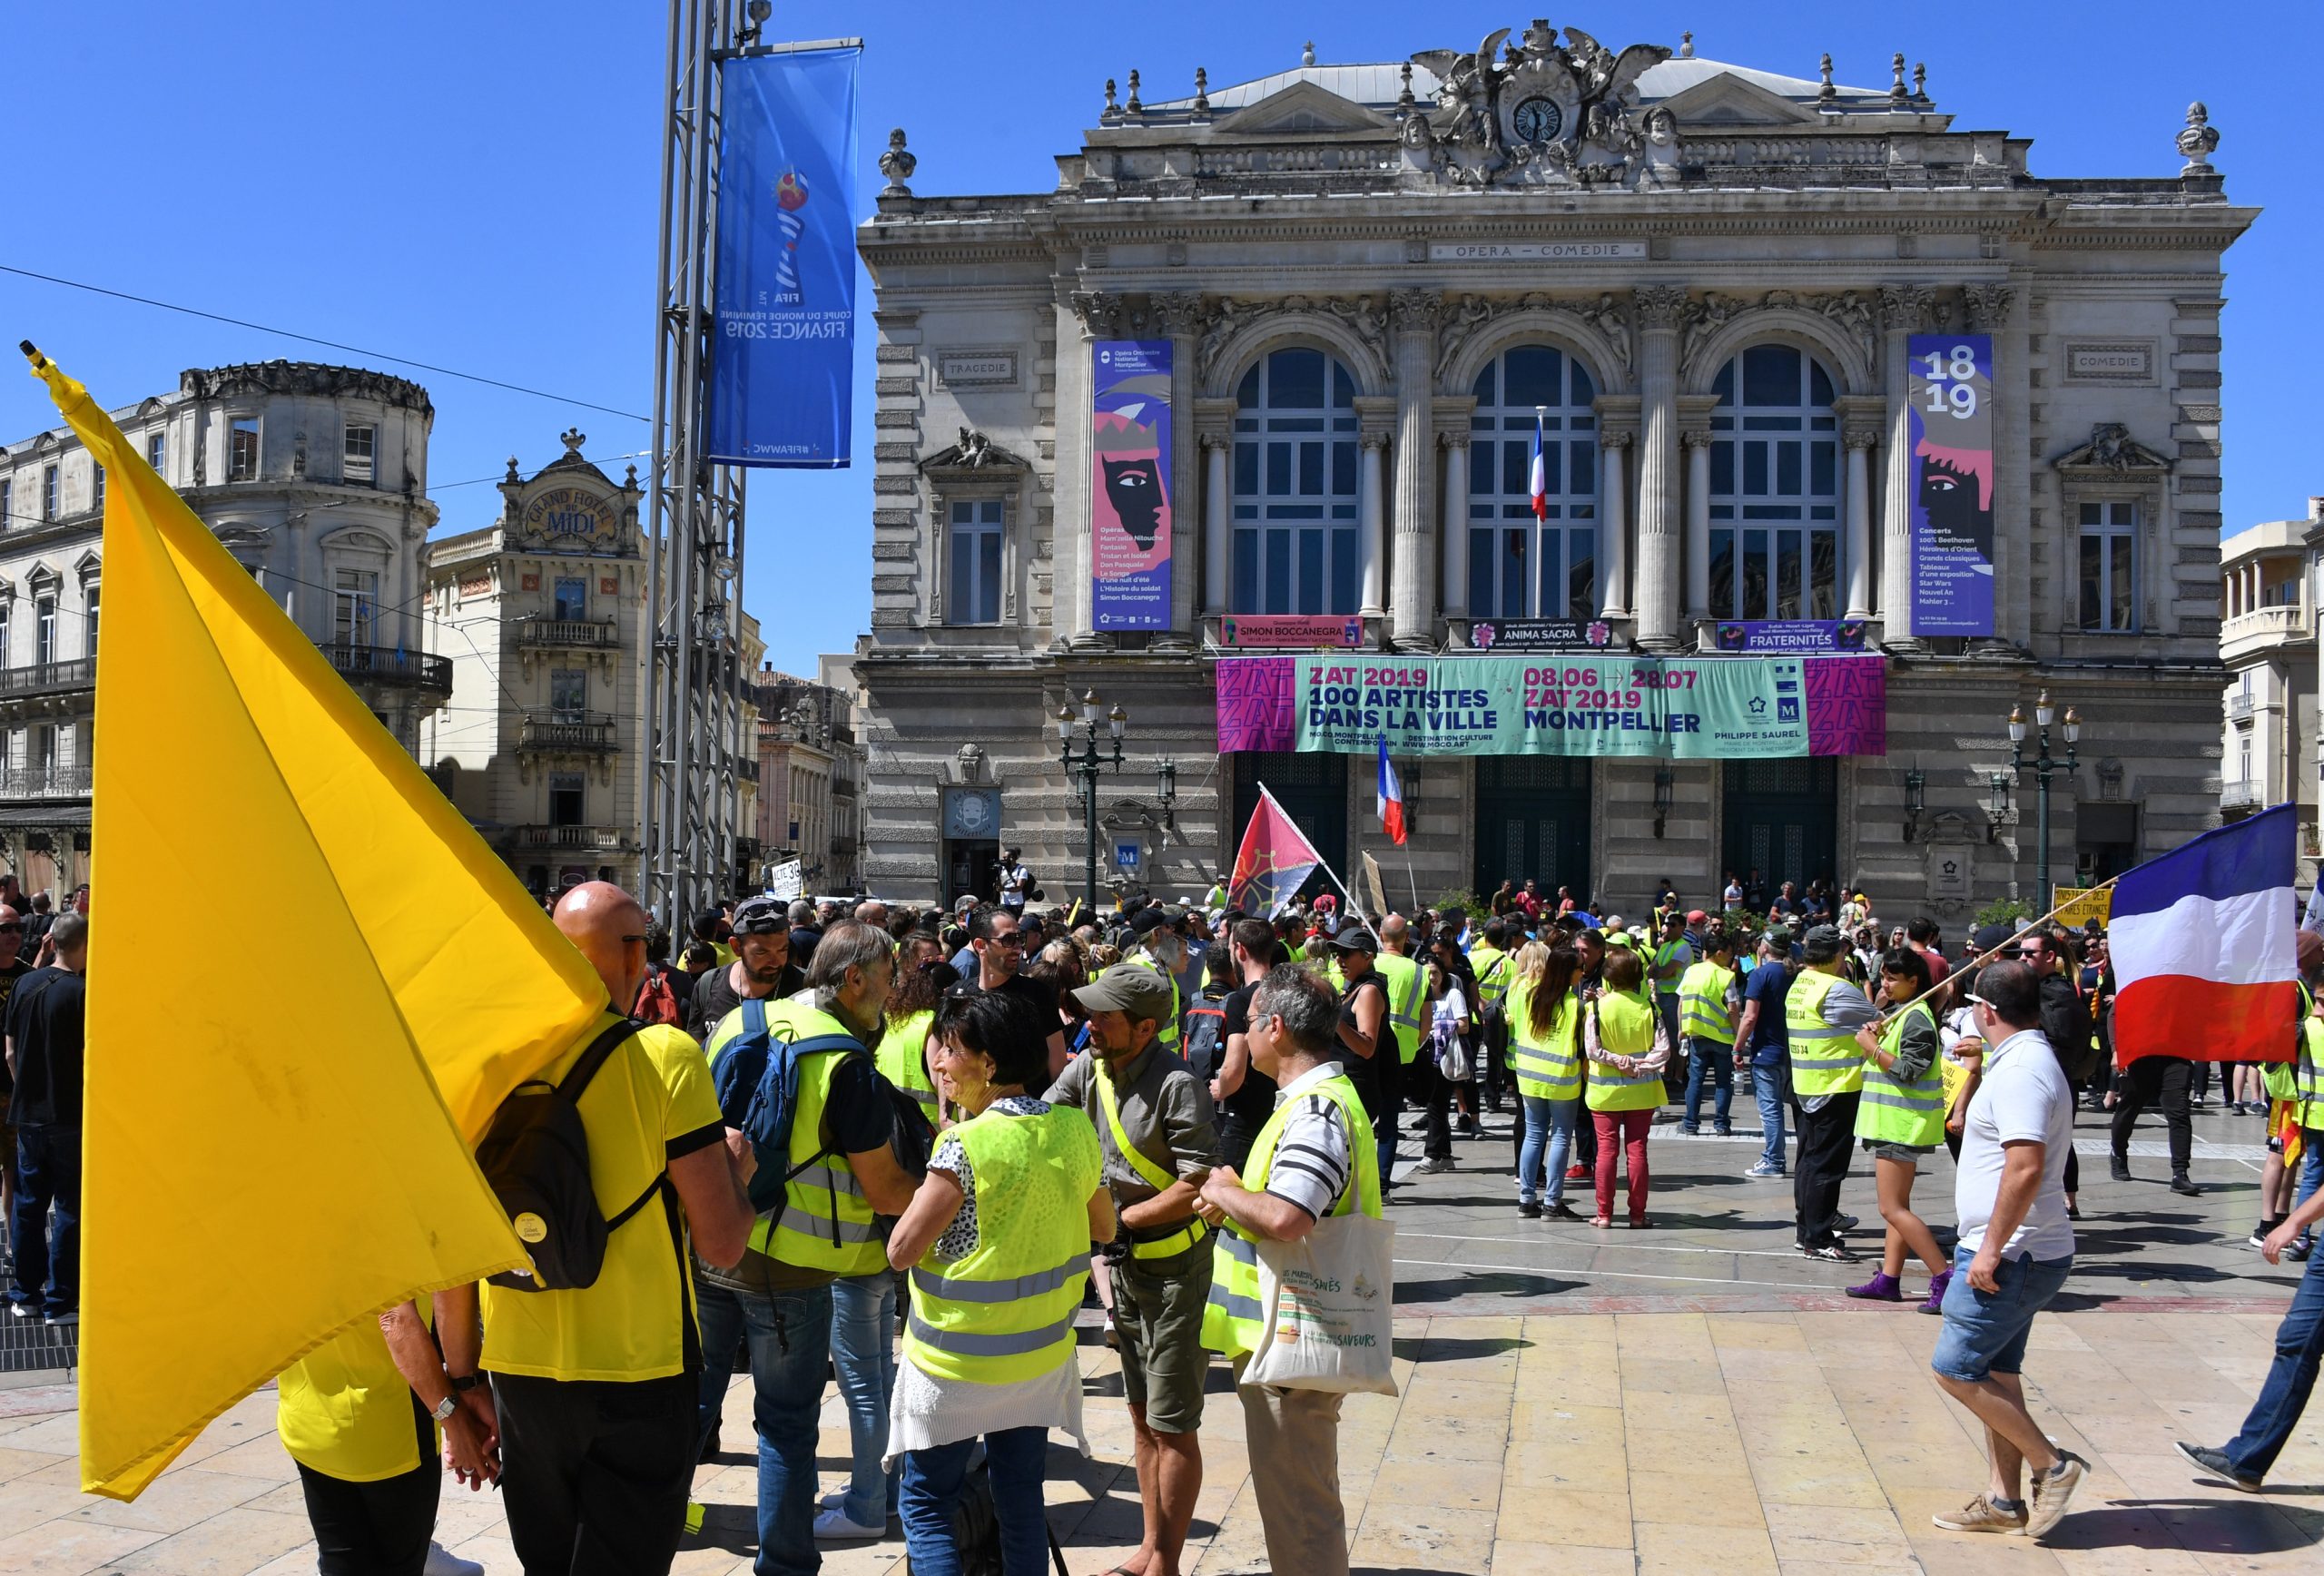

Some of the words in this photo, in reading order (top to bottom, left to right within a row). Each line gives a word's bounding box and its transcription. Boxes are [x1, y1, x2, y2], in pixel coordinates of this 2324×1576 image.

[1456, 246, 1512, 257] OPERA
[1541, 245, 1620, 256] COMEDIE
[1925, 345, 1976, 380] 18
[2079, 357, 2139, 366] COMEDIE
[949, 364, 1006, 374] TRAGEDIE
[1925, 383, 1976, 419] 19
[529, 491, 569, 522] GRAND
[574, 492, 611, 523] HOTEL
[547, 512, 595, 533] MIDI
[1240, 627, 1272, 635] SIMON
[1275, 627, 1342, 636] BOCCANEGRA
[1504, 630, 1539, 640] ANIMA
[1541, 629, 1577, 639] SACRA
[1750, 632, 1832, 646] FRATERNITÉS
[1309, 667, 1357, 685] ZAT
[1364, 668, 1428, 687] 2019
[1524, 668, 1598, 687] 08.06
[1630, 670, 1698, 690] 28.07
[1309, 687, 1359, 705] 100
[1364, 688, 1489, 709] ARTISTES
[1524, 689, 1572, 708] ZAT
[1575, 689, 1641, 709] 2019
[1782, 705, 1795, 717] M
[1309, 708, 1379, 728] DANS
[1386, 710, 1421, 730] LA
[1427, 710, 1497, 730] VILLE
[1524, 710, 1700, 733] MONTPELLIER
[1762, 730, 1801, 739] SAUREL
[963, 790, 992, 802] Comédie
[1121, 851, 1134, 862] M
[1313, 1277, 1341, 1292] SAVÈS
[1337, 1334, 1376, 1347] SAVEURS
